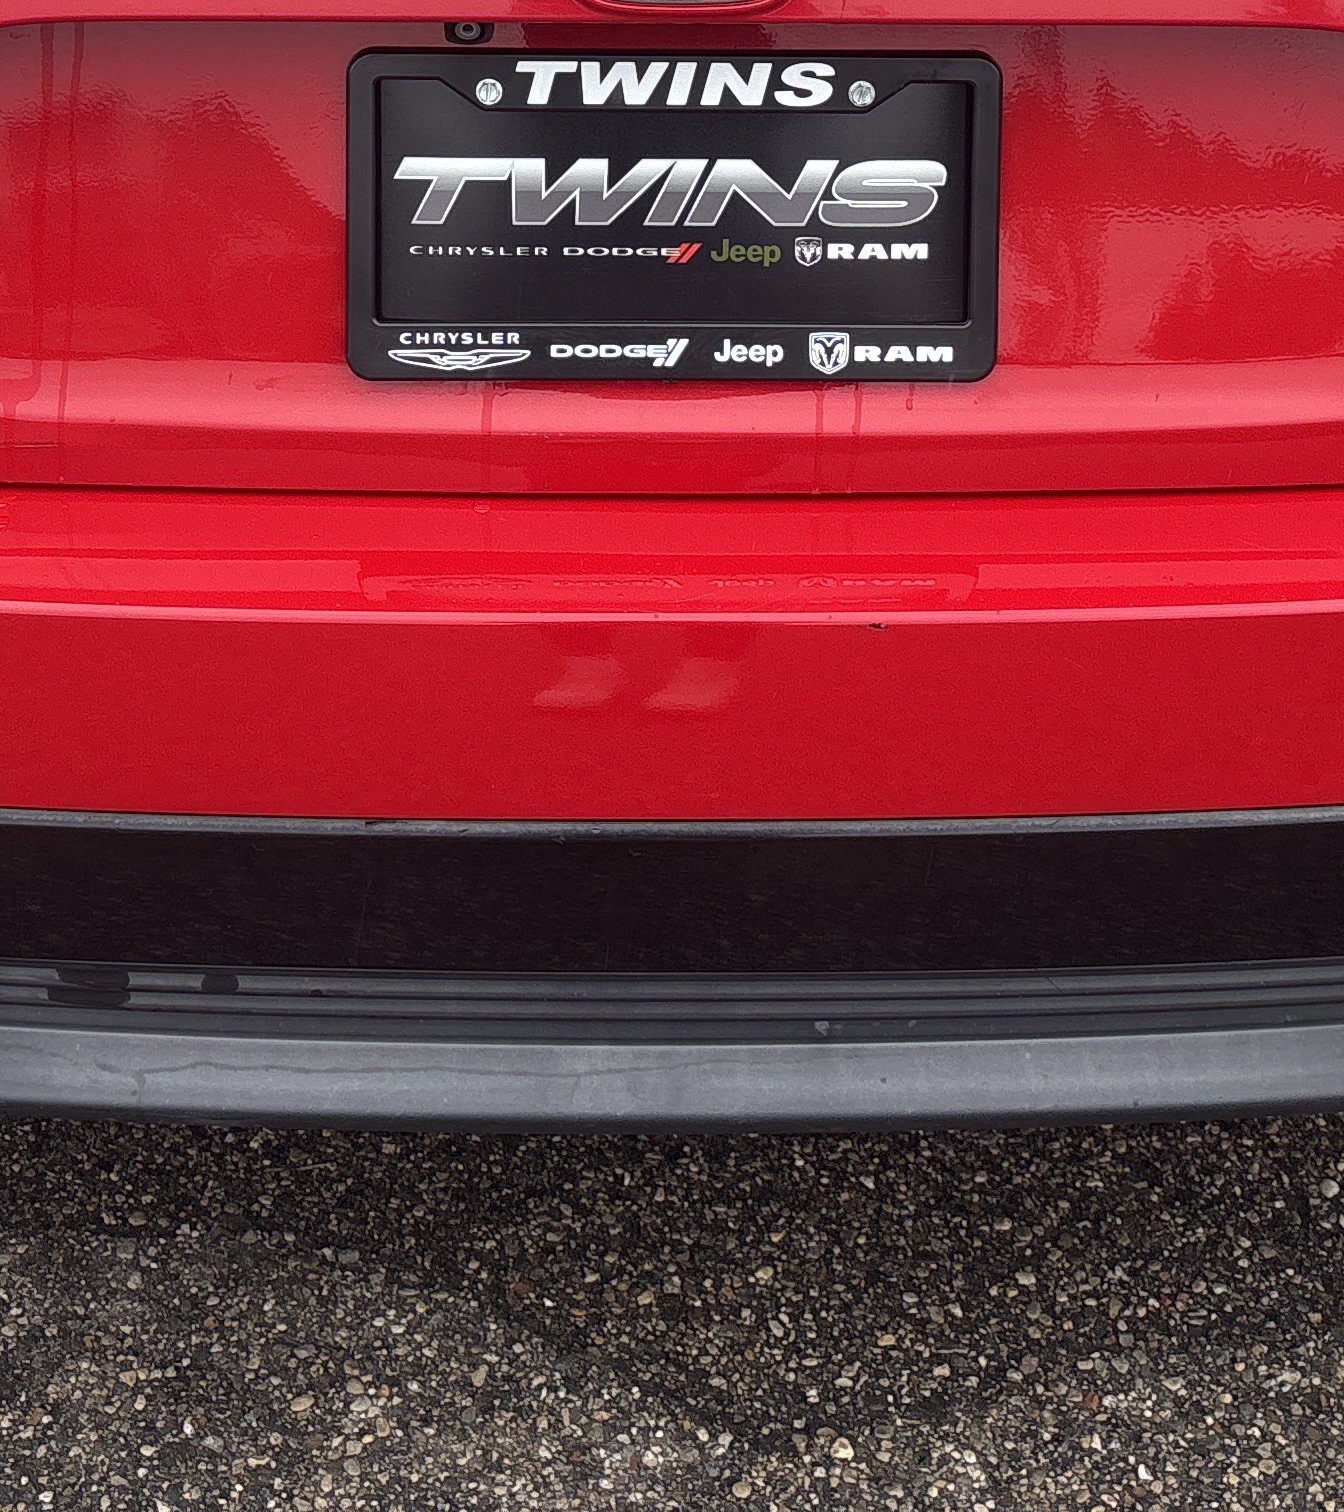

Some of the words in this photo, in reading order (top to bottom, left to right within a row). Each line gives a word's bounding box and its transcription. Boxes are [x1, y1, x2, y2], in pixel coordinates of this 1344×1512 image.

[515, 61, 836, 107] TWINS
[392, 157, 948, 227] TWINS
[409, 245, 548, 257] CHRYSLER
[562, 246, 682, 257] DODGE
[710, 238, 782, 267] Jeep
[827, 243, 929, 260] RAM
[399, 332, 521, 345] CHRYSLER
[550, 344, 670, 358] DODGE
[713, 339, 784, 367] Jeep
[854, 345, 954, 362] RAM
